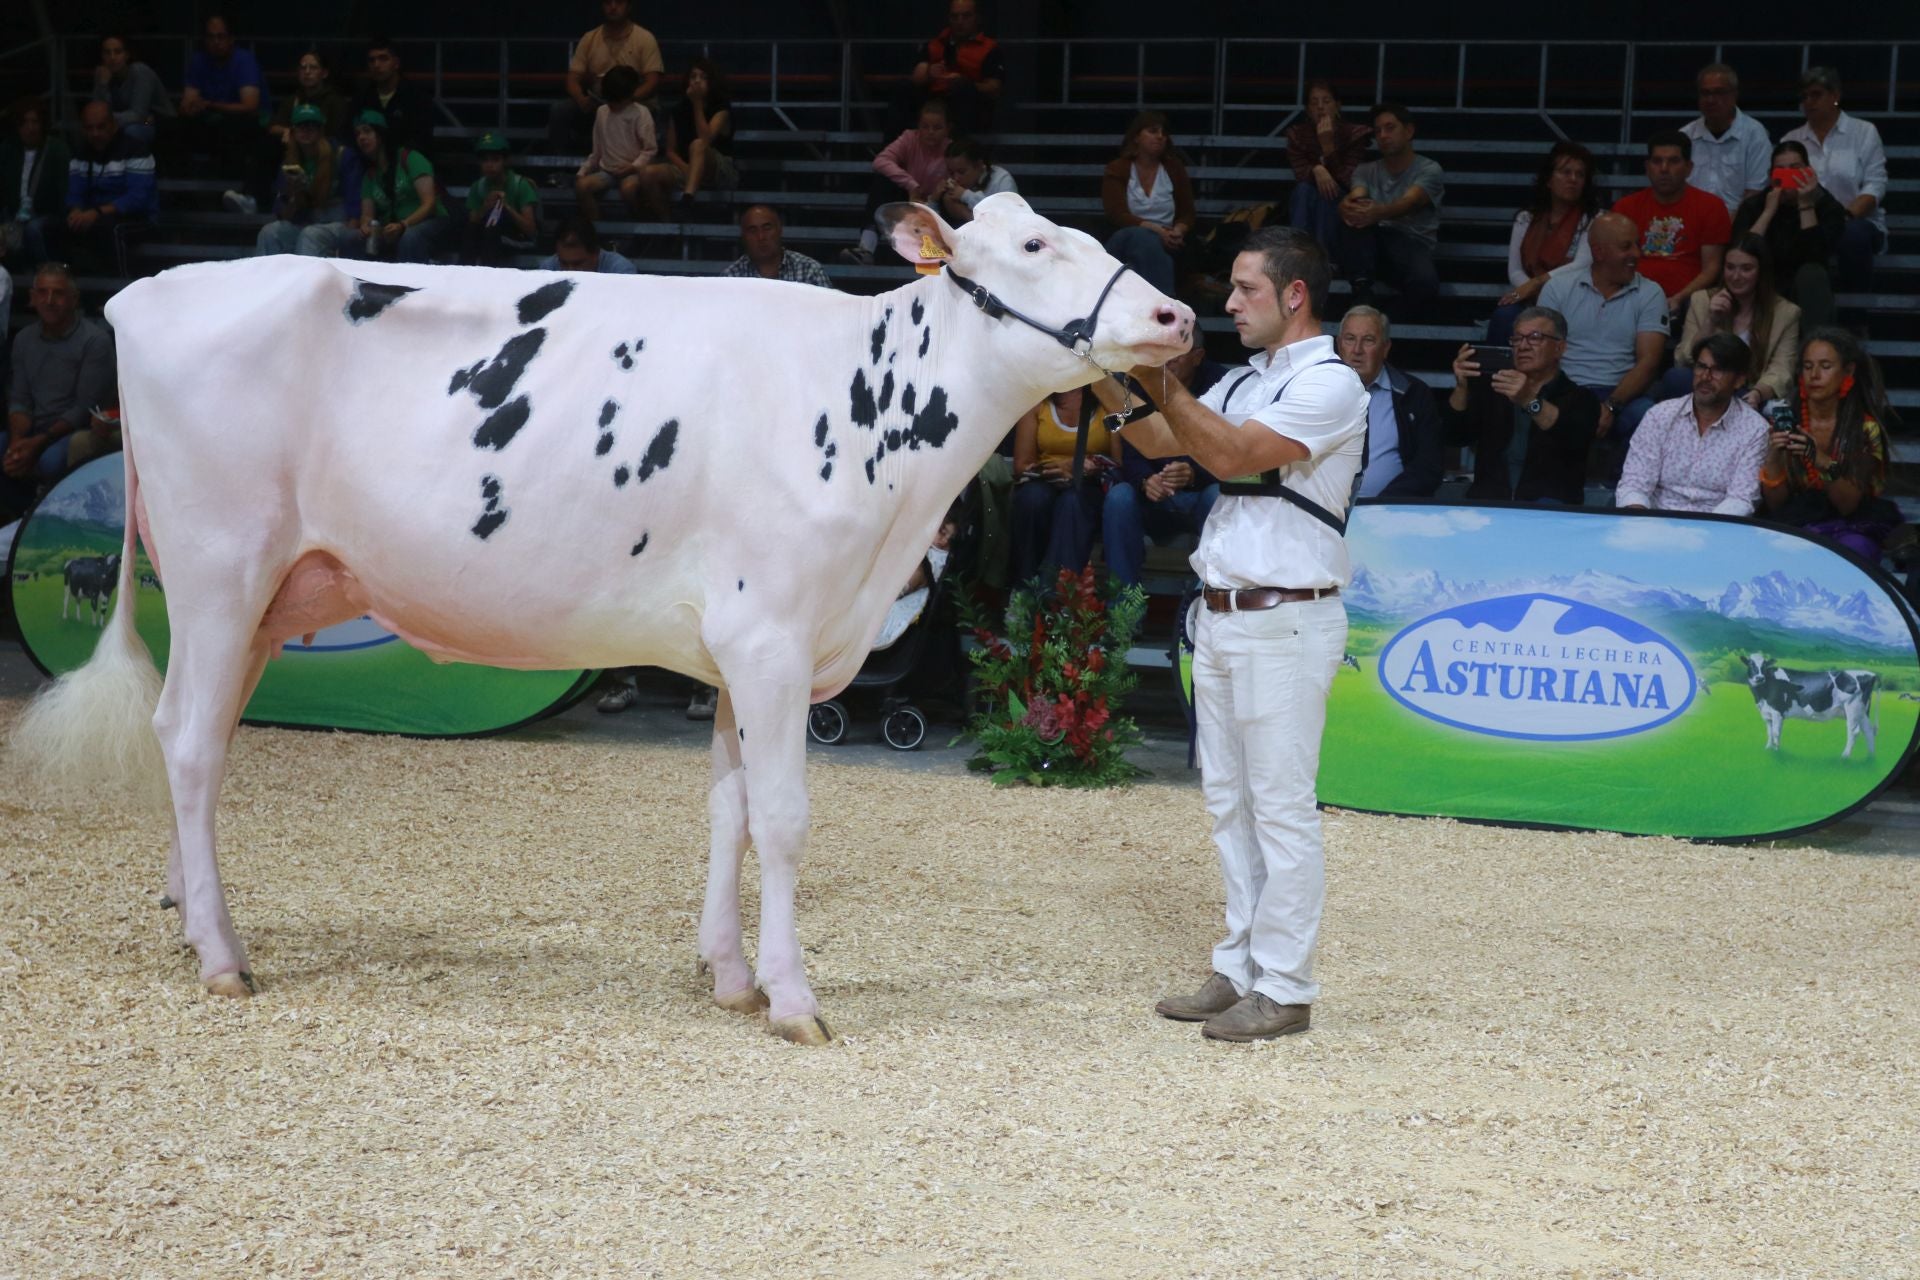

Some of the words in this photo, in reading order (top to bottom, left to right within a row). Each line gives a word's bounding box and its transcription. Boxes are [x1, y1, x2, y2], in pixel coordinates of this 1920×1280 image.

[1400, 639, 1670, 710] ASTURIANA
[1453, 640, 1550, 658] CENTRAL
[1561, 646, 1663, 665] LECHERA
